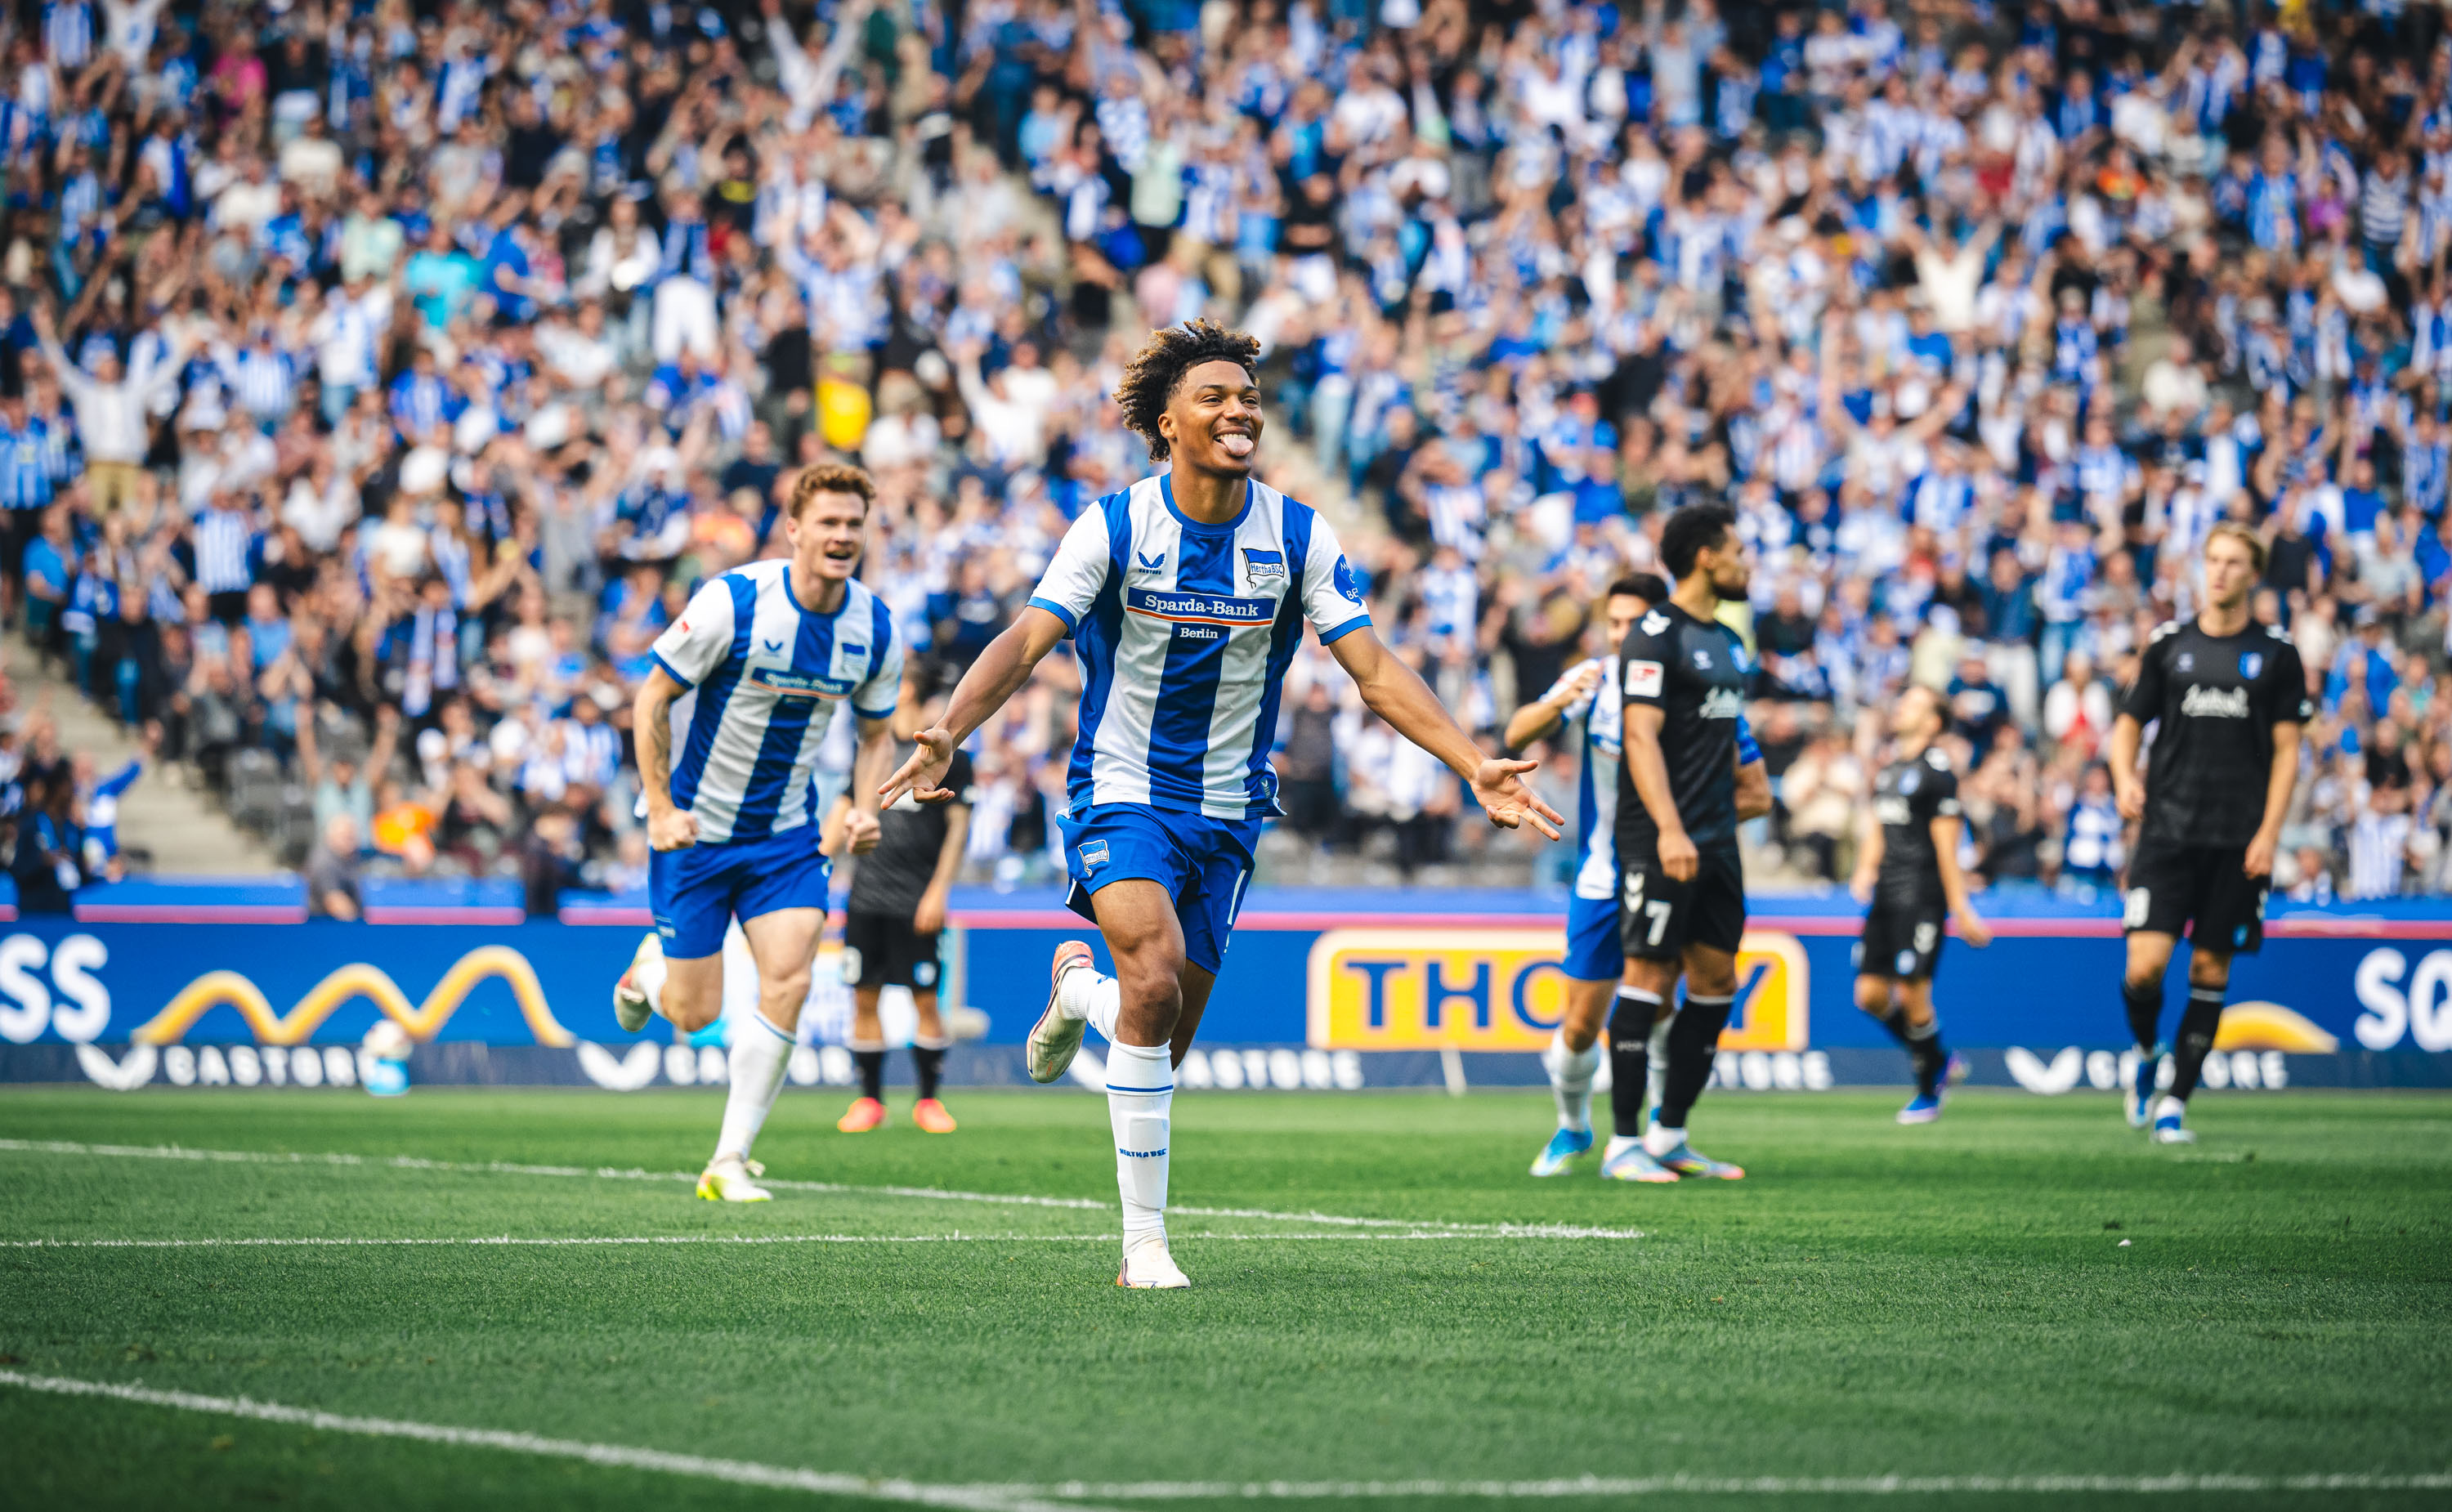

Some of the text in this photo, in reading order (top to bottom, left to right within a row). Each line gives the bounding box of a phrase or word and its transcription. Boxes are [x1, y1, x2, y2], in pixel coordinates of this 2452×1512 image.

[1145, 595, 1259, 616] Sparda-Bank
[1179, 628, 1219, 639] Berlin
[1646, 900, 1671, 946] 7
[1345, 961, 1770, 1029] THOY
